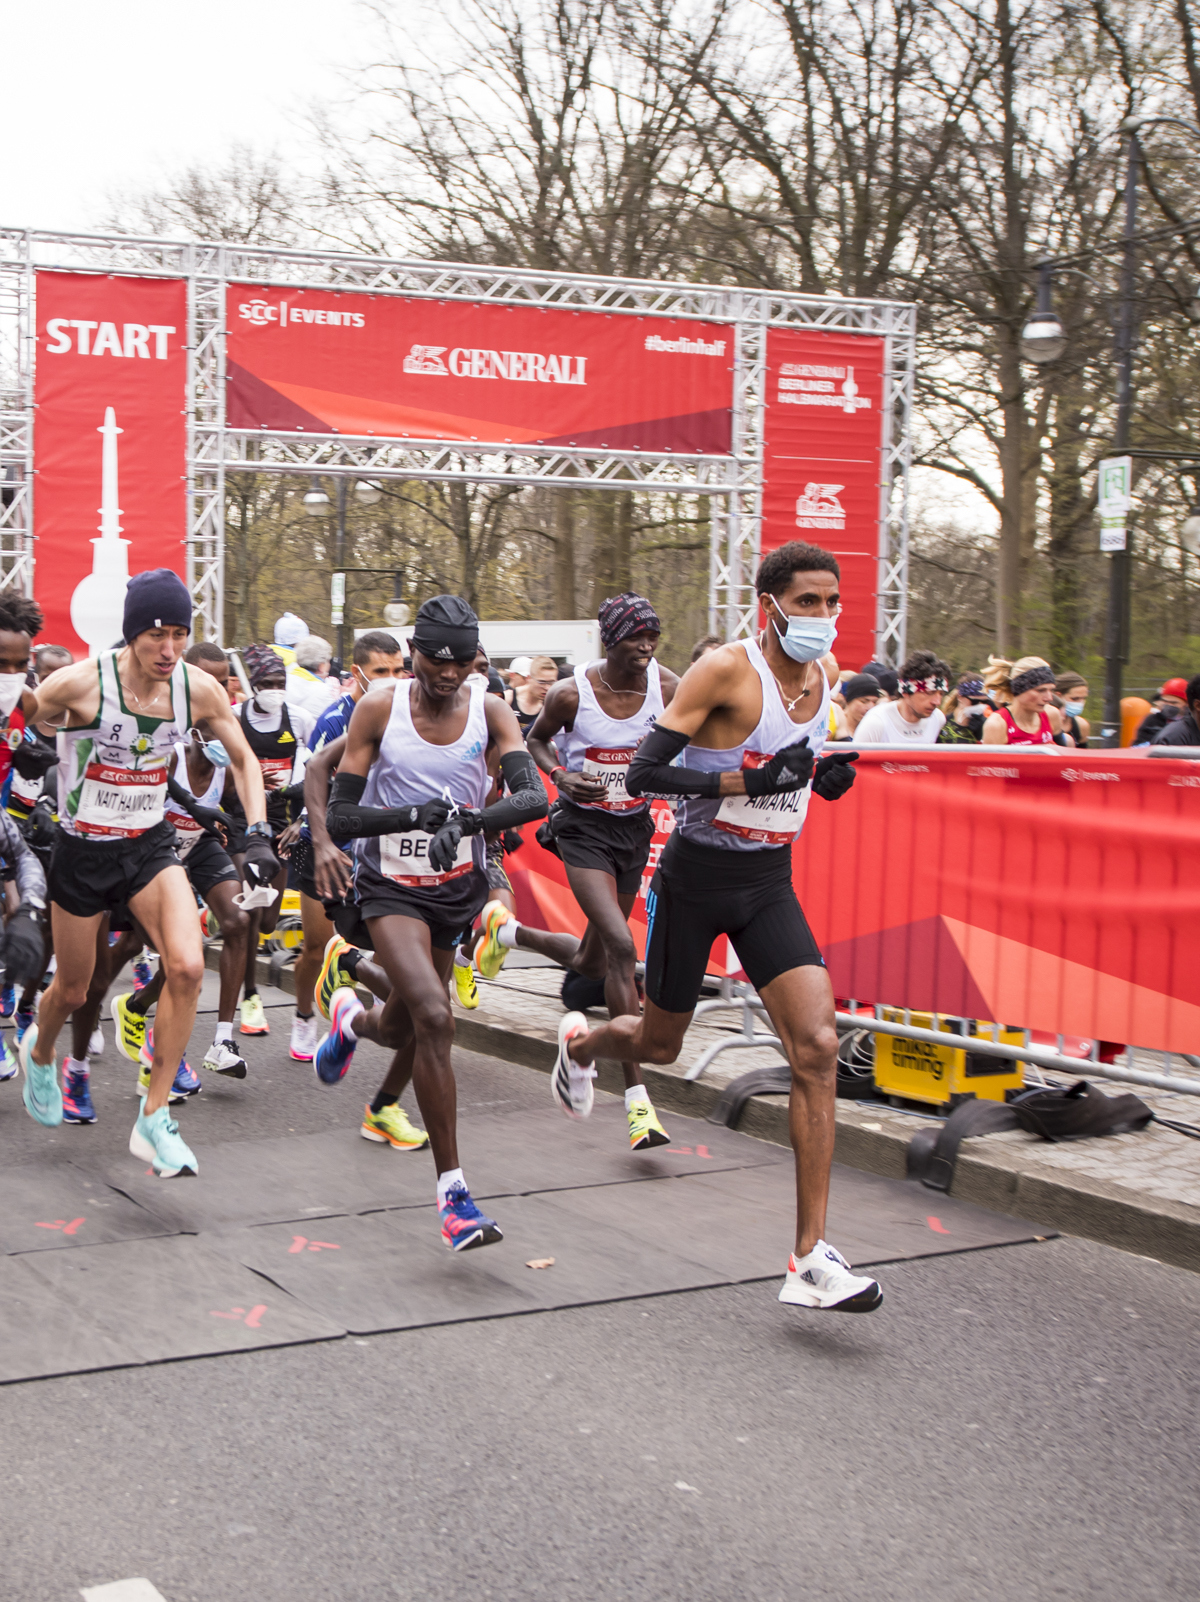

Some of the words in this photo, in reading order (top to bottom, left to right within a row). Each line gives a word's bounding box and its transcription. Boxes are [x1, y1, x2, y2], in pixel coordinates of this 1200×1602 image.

[238, 299, 278, 325] SCC
[290, 308, 365, 328] EVENTS
[46, 318, 176, 360] START
[644, 334, 727, 356] #berlinhalf
[448, 347, 588, 385] GENERALI
[115, 772, 161, 783] GENERALI
[595, 771, 626, 787] KIPR
[637, 791, 685, 801] TERREX
[744, 790, 802, 813] AMANAL
[399, 838, 428, 858] BE
[892, 1052, 945, 1081] timing
